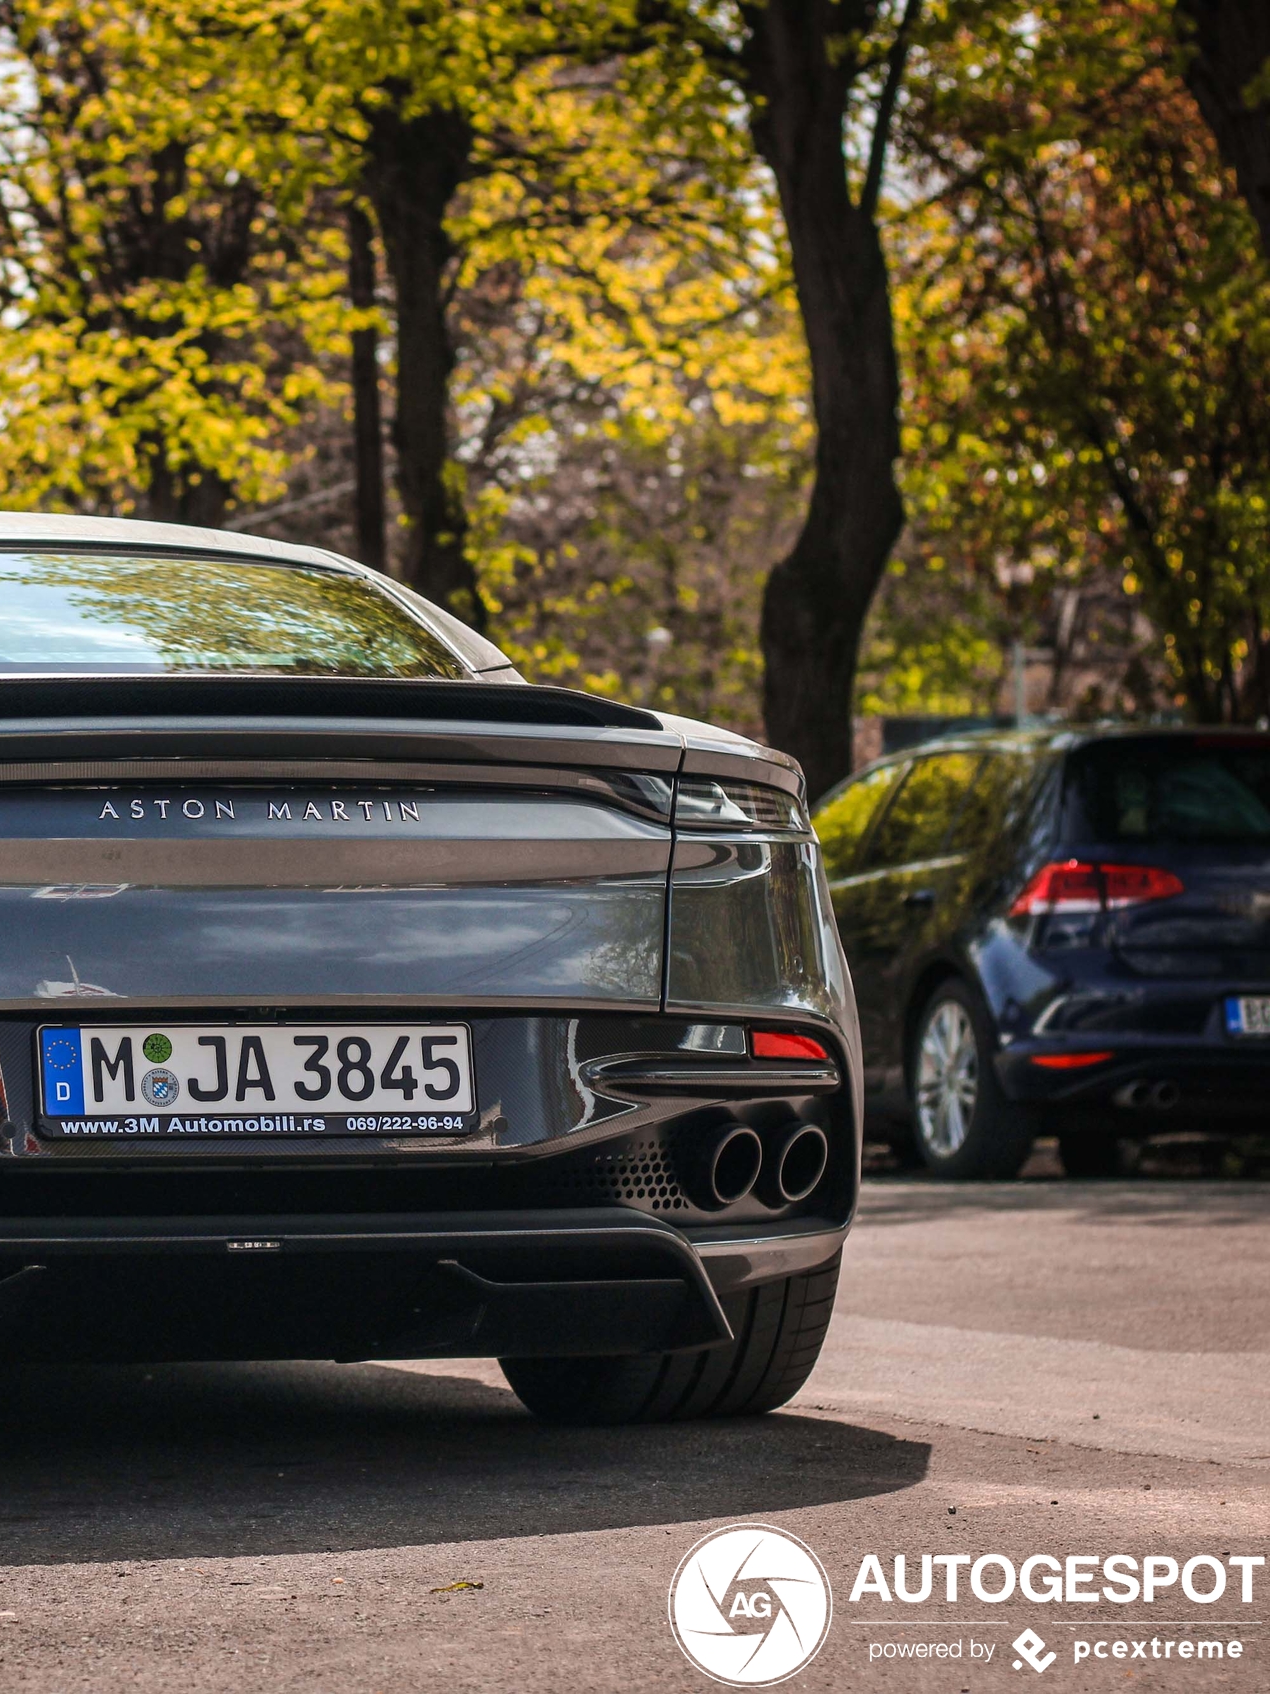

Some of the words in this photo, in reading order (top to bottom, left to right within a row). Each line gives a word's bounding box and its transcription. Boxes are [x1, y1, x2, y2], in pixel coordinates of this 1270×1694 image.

[98, 799, 236, 820] ASTON
[267, 800, 420, 822] MARTIN
[91, 1036, 136, 1102] M
[187, 1035, 276, 1102] JA
[293, 1035, 458, 1101] 3845
[56, 1082, 71, 1101] D
[60, 1117, 160, 1134] www.3M
[166, 1115, 326, 1133] Automobili.rs
[346, 1115, 464, 1132] 069/222-96-94
